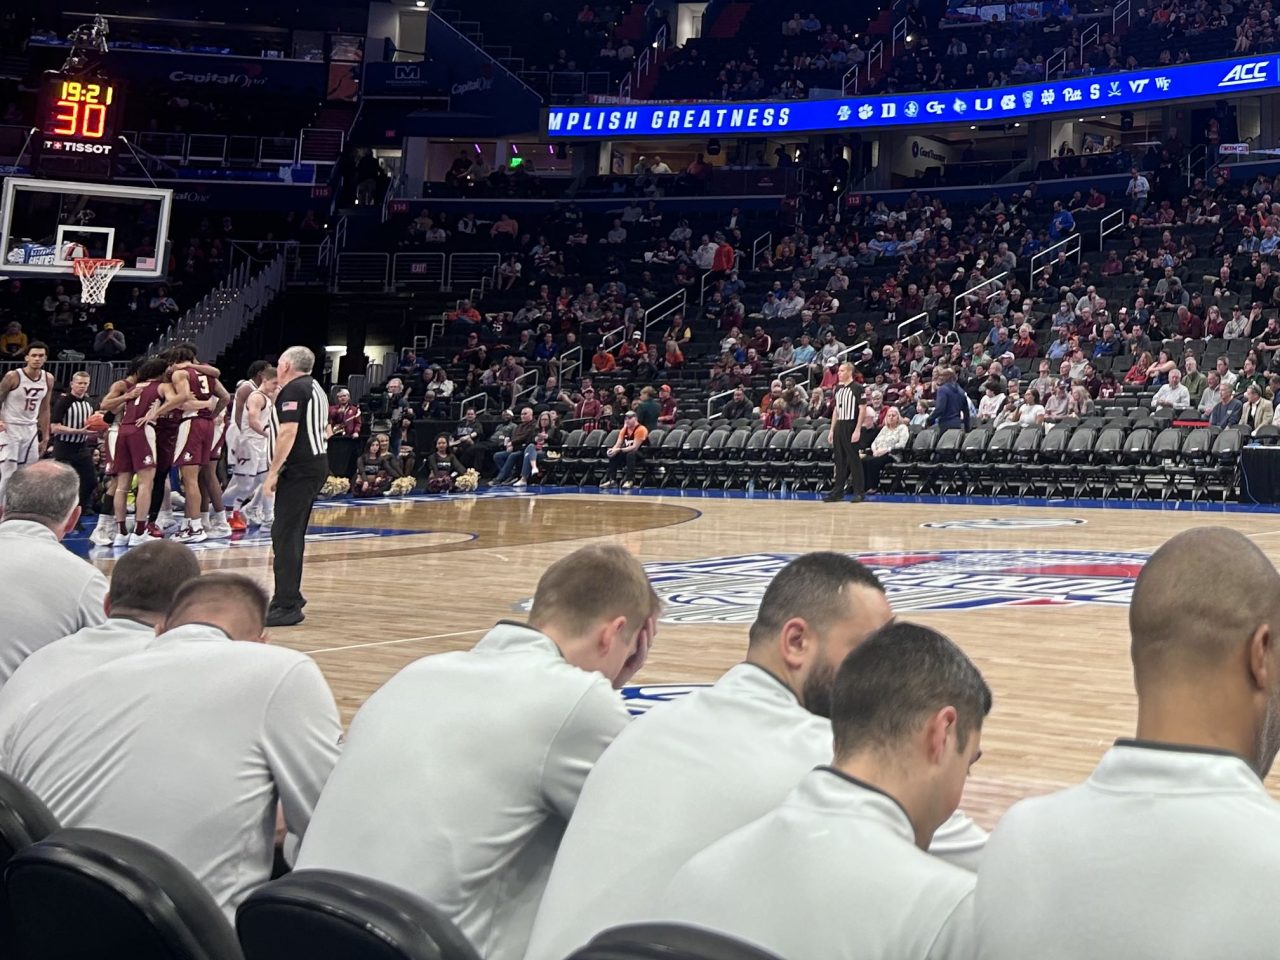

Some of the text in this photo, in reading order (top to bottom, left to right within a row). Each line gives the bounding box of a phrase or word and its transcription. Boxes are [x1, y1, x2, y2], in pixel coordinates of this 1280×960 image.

[1220, 61, 1269, 84] ACC
[61, 81, 113, 105] 19:21
[1063, 88, 1082, 101] Pitt
[1129, 79, 1149, 93] VT
[54, 101, 106, 138] 30
[651, 107, 790, 129] GREATNESS
[64, 142, 113, 154] TISSOT
[24, 398, 37, 412] 15
